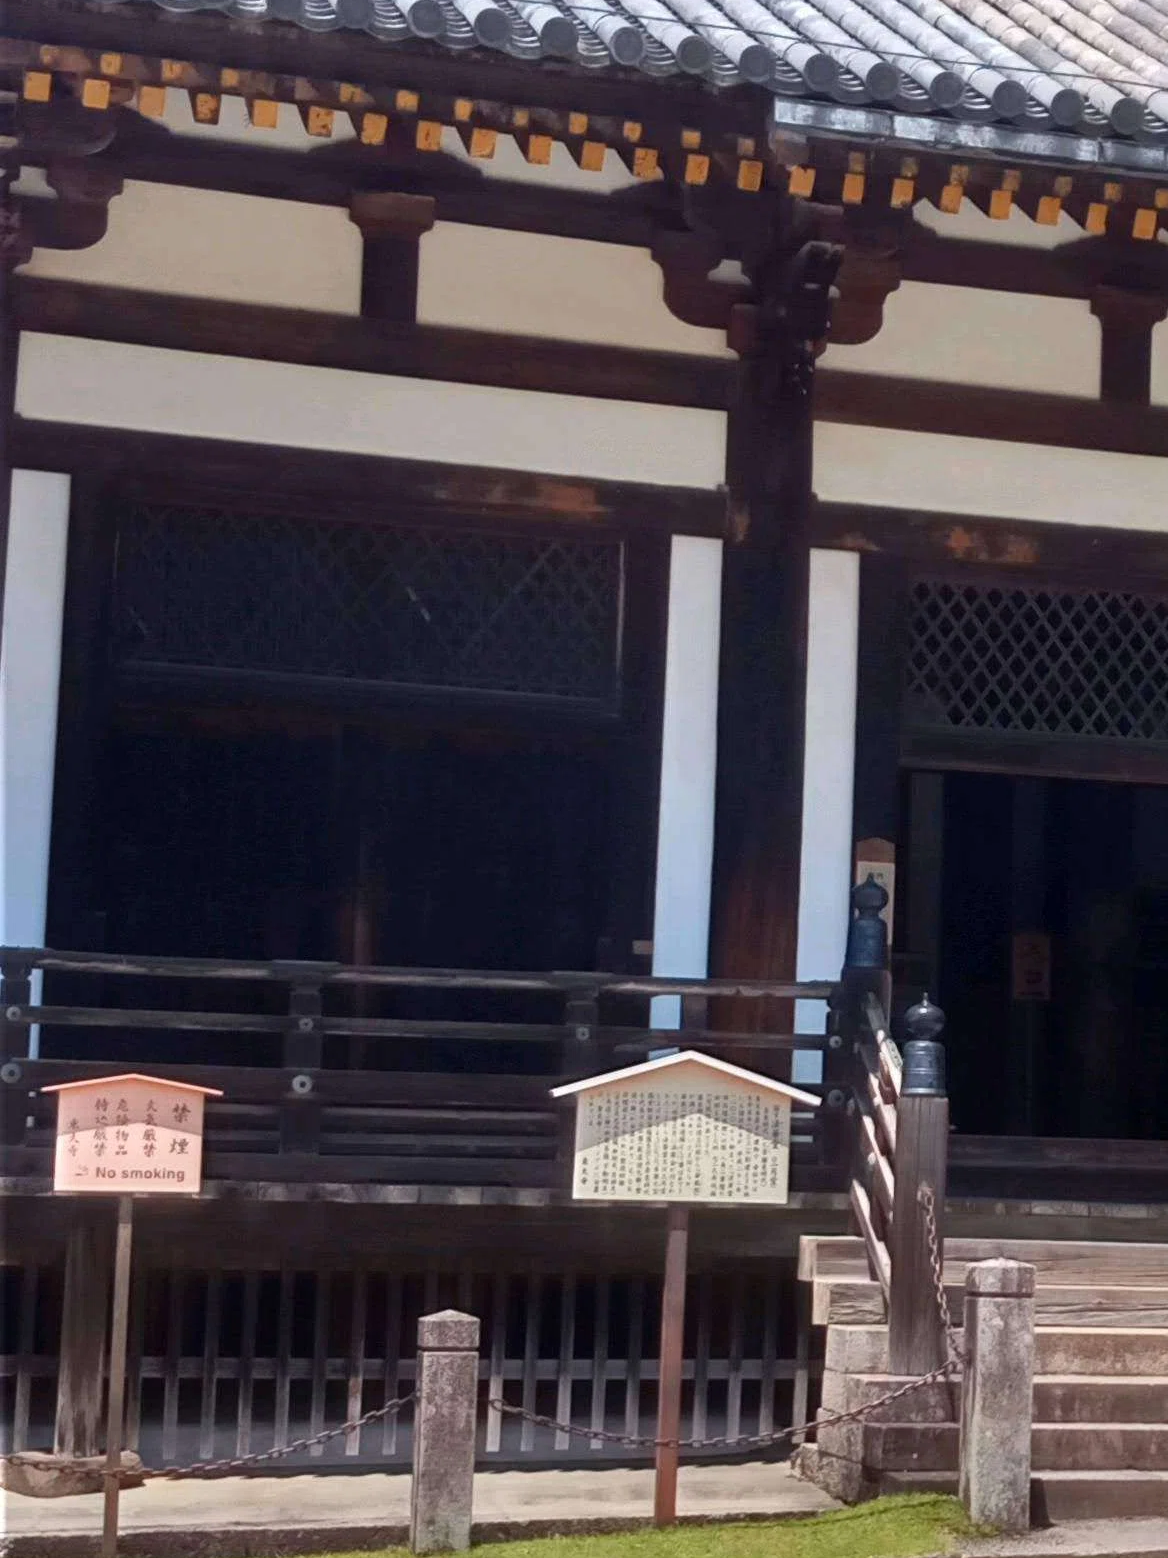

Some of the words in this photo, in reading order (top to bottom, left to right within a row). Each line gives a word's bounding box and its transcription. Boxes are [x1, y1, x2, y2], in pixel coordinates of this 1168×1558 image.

[168, 1103, 191, 1155] 禁煙
[96, 1167, 116, 1179] No
[121, 1167, 185, 1183] smoking
